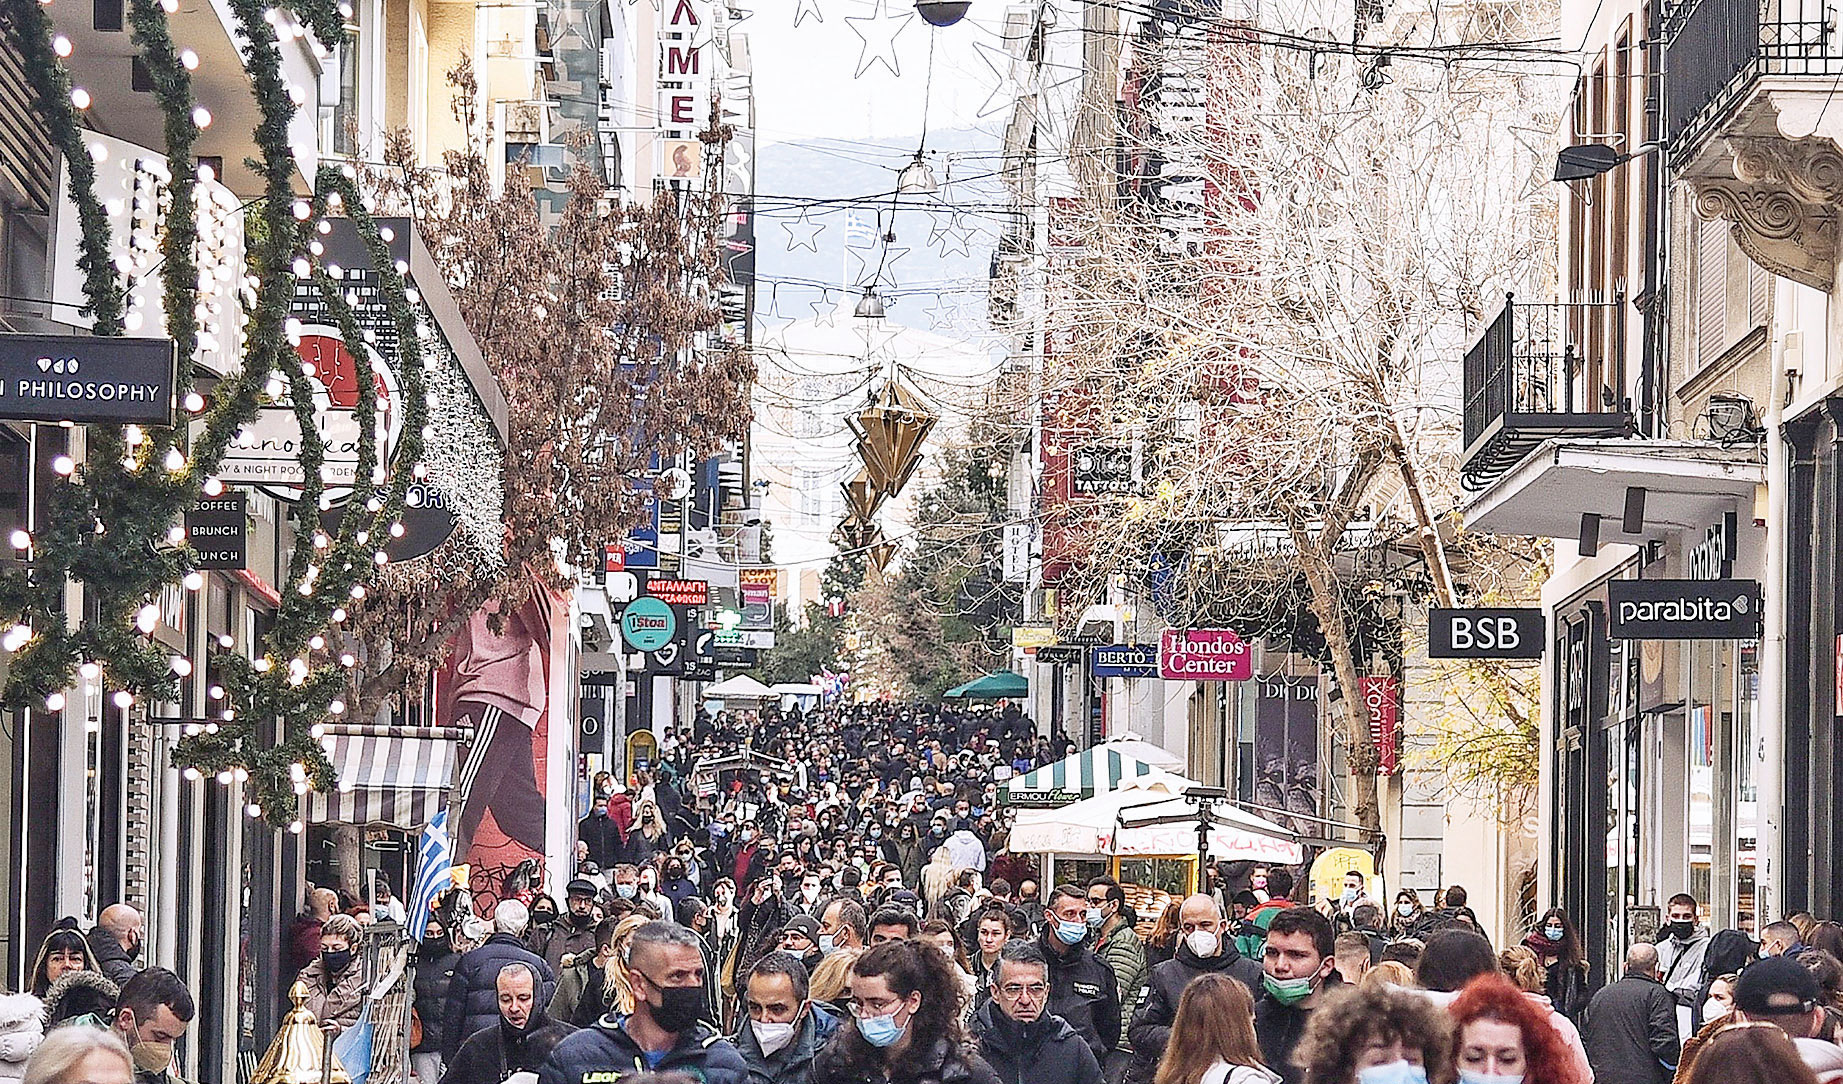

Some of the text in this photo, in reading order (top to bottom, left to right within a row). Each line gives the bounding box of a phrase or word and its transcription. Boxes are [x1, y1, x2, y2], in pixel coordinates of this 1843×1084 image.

[19, 380, 160, 402] PHILOSOPHY
[234, 465, 240, 473] &
[244, 465, 277, 474] NIGHT
[281, 466, 304, 475] ROO
[192, 526, 238, 536] BRUNCH
[199, 551, 238, 561] UNCH
[1620, 597, 1731, 624] parabita
[1451, 617, 1520, 649] BSB
[1169, 635, 1244, 655] Hondos
[1098, 652, 1146, 664] BERTO
[1169, 653, 1237, 674] Center
[1010, 789, 1080, 801] ERMOU Flower
